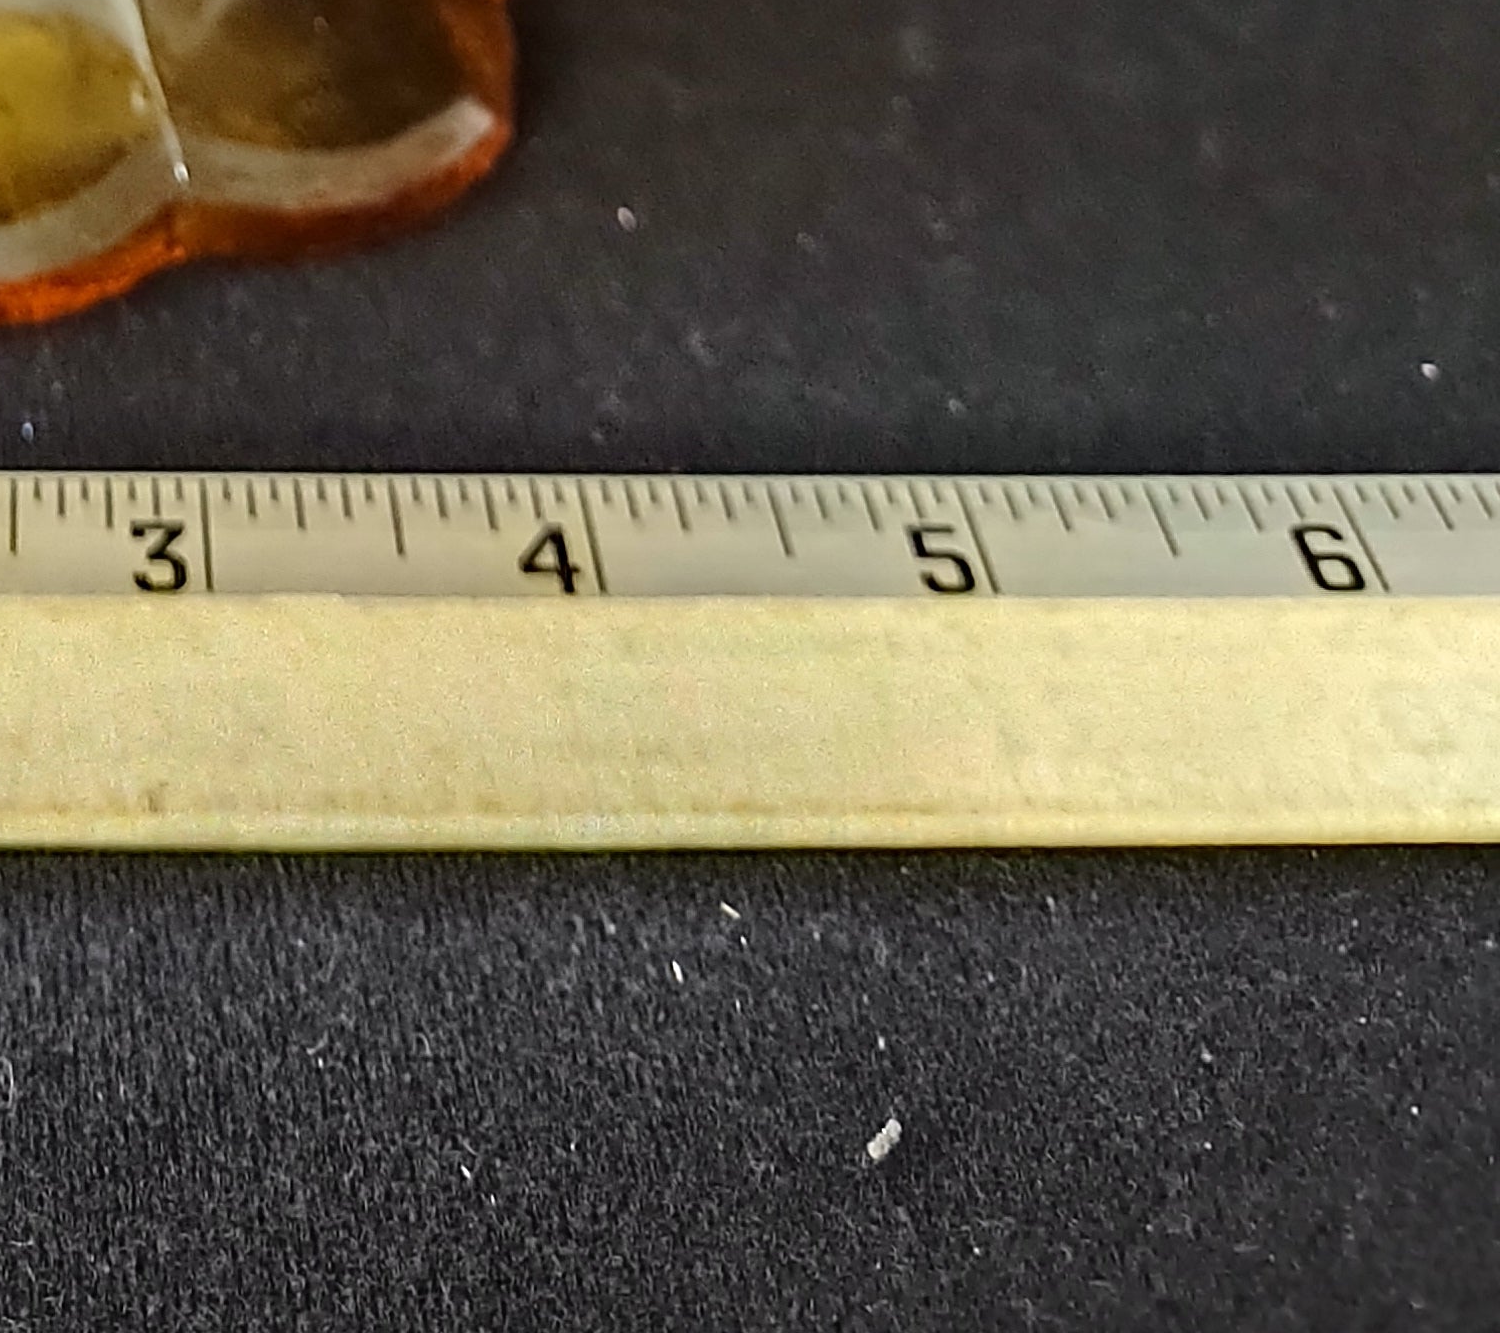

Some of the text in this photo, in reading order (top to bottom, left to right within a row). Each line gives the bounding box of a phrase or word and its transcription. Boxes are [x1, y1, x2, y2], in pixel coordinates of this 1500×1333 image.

[130, 519, 187, 592] 3
[518, 523, 581, 595] 4
[907, 523, 977, 595] 5
[1292, 523, 1367, 593] 6
